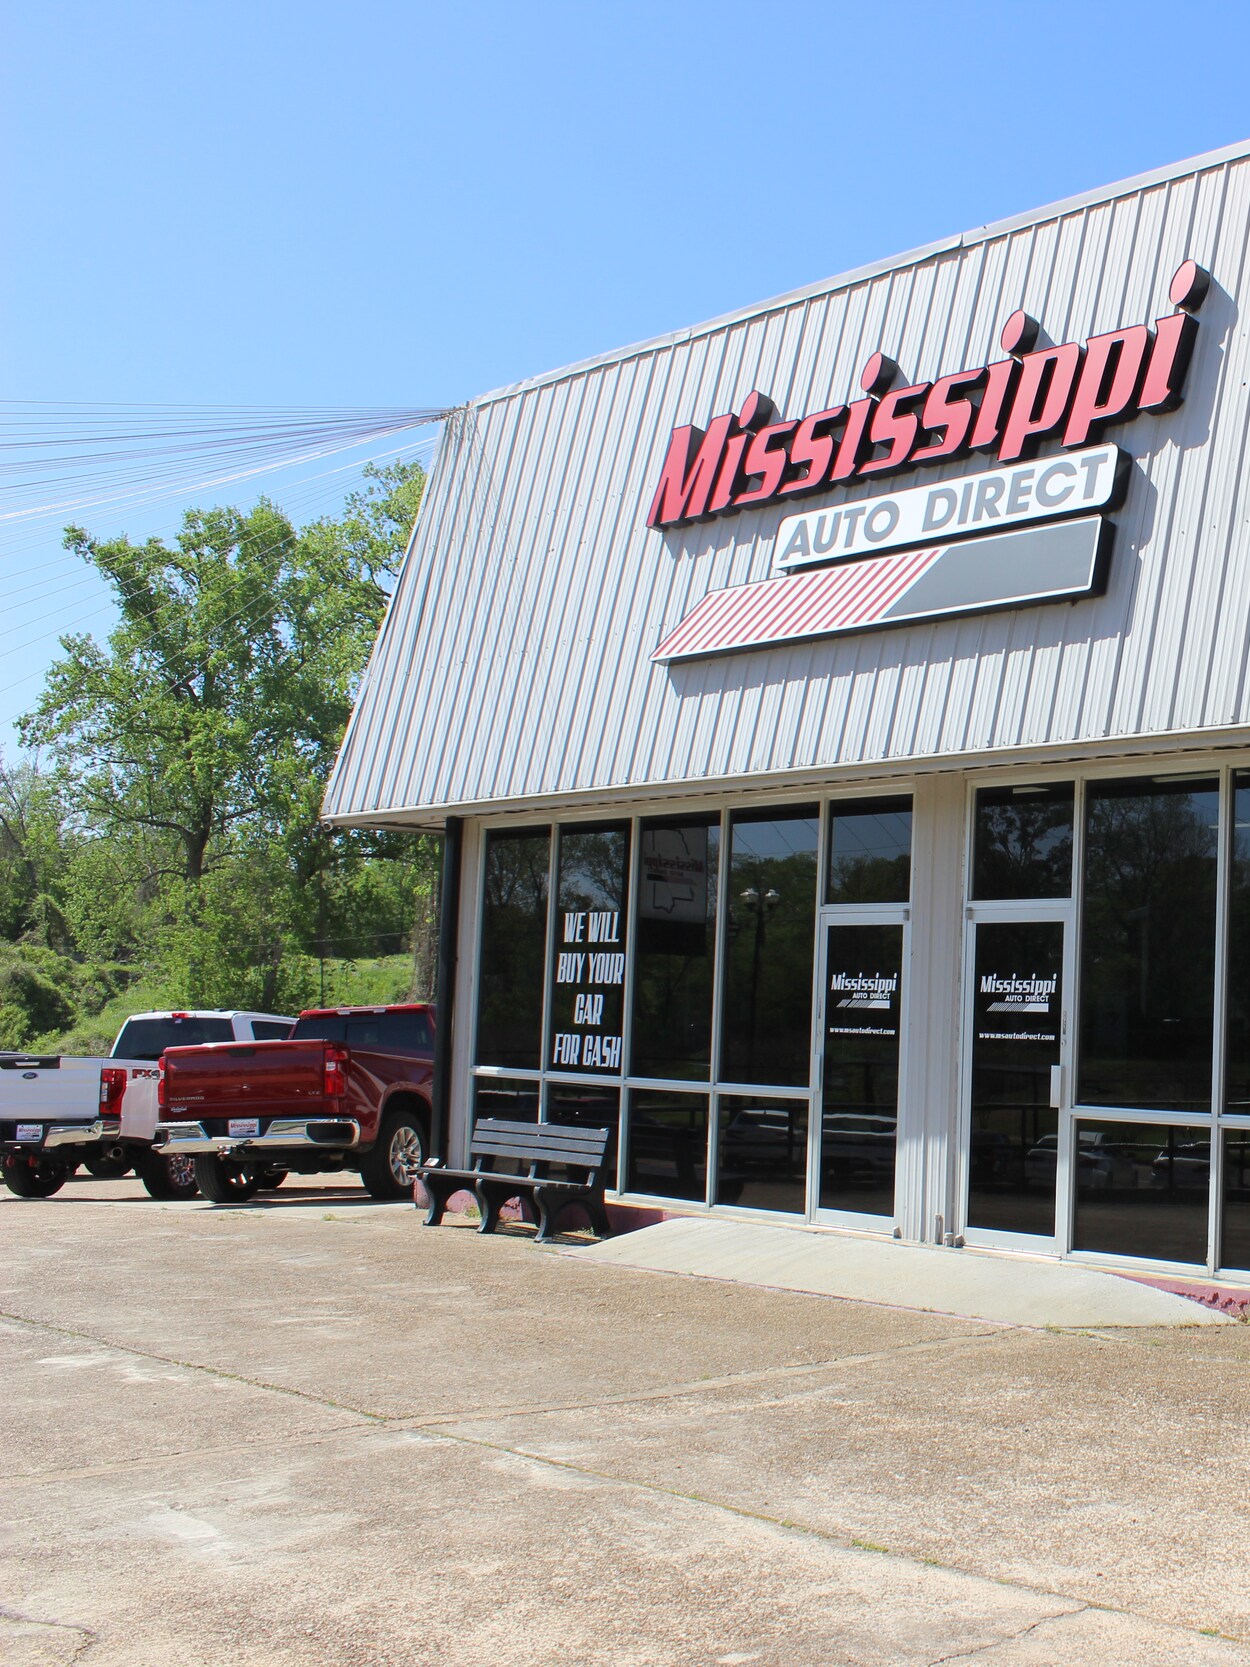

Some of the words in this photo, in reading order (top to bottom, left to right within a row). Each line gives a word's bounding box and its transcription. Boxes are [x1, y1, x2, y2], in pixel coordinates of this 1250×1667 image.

[647, 259, 1206, 530] Mississippi
[779, 502, 899, 561] AUTO
[921, 453, 1110, 533] DIRECT
[564, 912, 586, 943] WE
[588, 911, 620, 943] WILL
[557, 953, 586, 984] BUY
[588, 953, 625, 985] YOUR
[831, 972, 897, 994] Mississippi
[980, 973, 1057, 996] Mississippi
[574, 994, 604, 1025] CAR
[830, 1026, 895, 1035] www.msautodirect.com
[979, 1032, 1055, 1040] www.msautodirect.com
[553, 1033, 581, 1065] FOR
[582, 1035, 622, 1068] CASH
